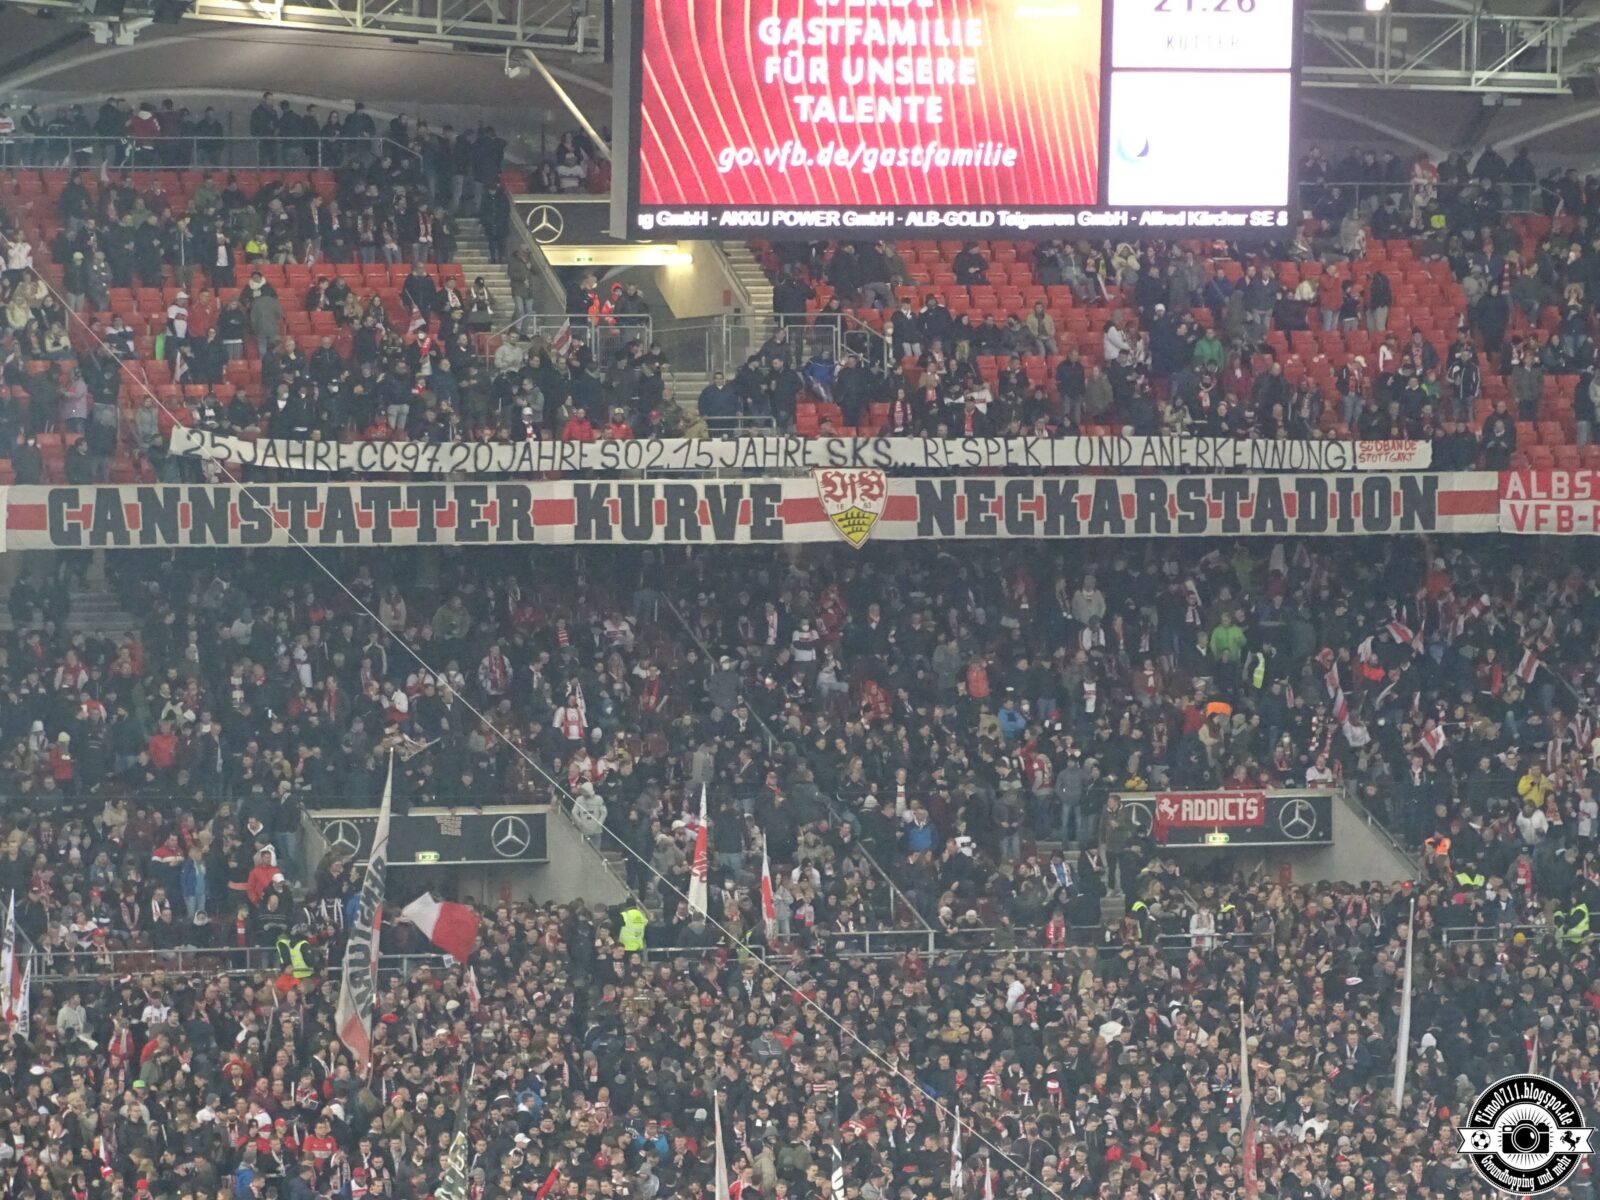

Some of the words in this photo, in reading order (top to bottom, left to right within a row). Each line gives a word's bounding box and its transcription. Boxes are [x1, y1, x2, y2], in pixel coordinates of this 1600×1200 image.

[758, 16, 982, 46] GASTFAMILIE
[765, 50, 829, 85] FÜR
[842, 56, 976, 86] UNSERE
[793, 95, 944, 124] TALENTE
[718, 139, 1017, 173] go.vfb.de/gastfamilie
[656, 210, 708, 226] GmbH
[719, 211, 770, 226] AKKU
[773, 211, 841, 226] POWER
[843, 211, 894, 226] GmbH
[905, 211, 994, 226] ALB-GOLD
[1077, 211, 1128, 226] GmbH
[1249, 210, 1275, 226] SE
[183, 429, 232, 461] 25
[237, 438, 353, 472] JAHRE
[449, 440, 493, 473] 20
[498, 440, 594, 472] JAHRE
[673, 438, 714, 470] 15
[720, 436, 819, 468] JAHRE
[924, 436, 1064, 468] RESPEKT
[1075, 434, 1132, 468] UND
[1505, 470, 1600, 499] ALBS
[48, 482, 534, 547] CANNSTATTER
[574, 482, 784, 543] KURVE
[915, 474, 1439, 537] NECKARSTADION
[1181, 796, 1259, 821] ADDICTS
